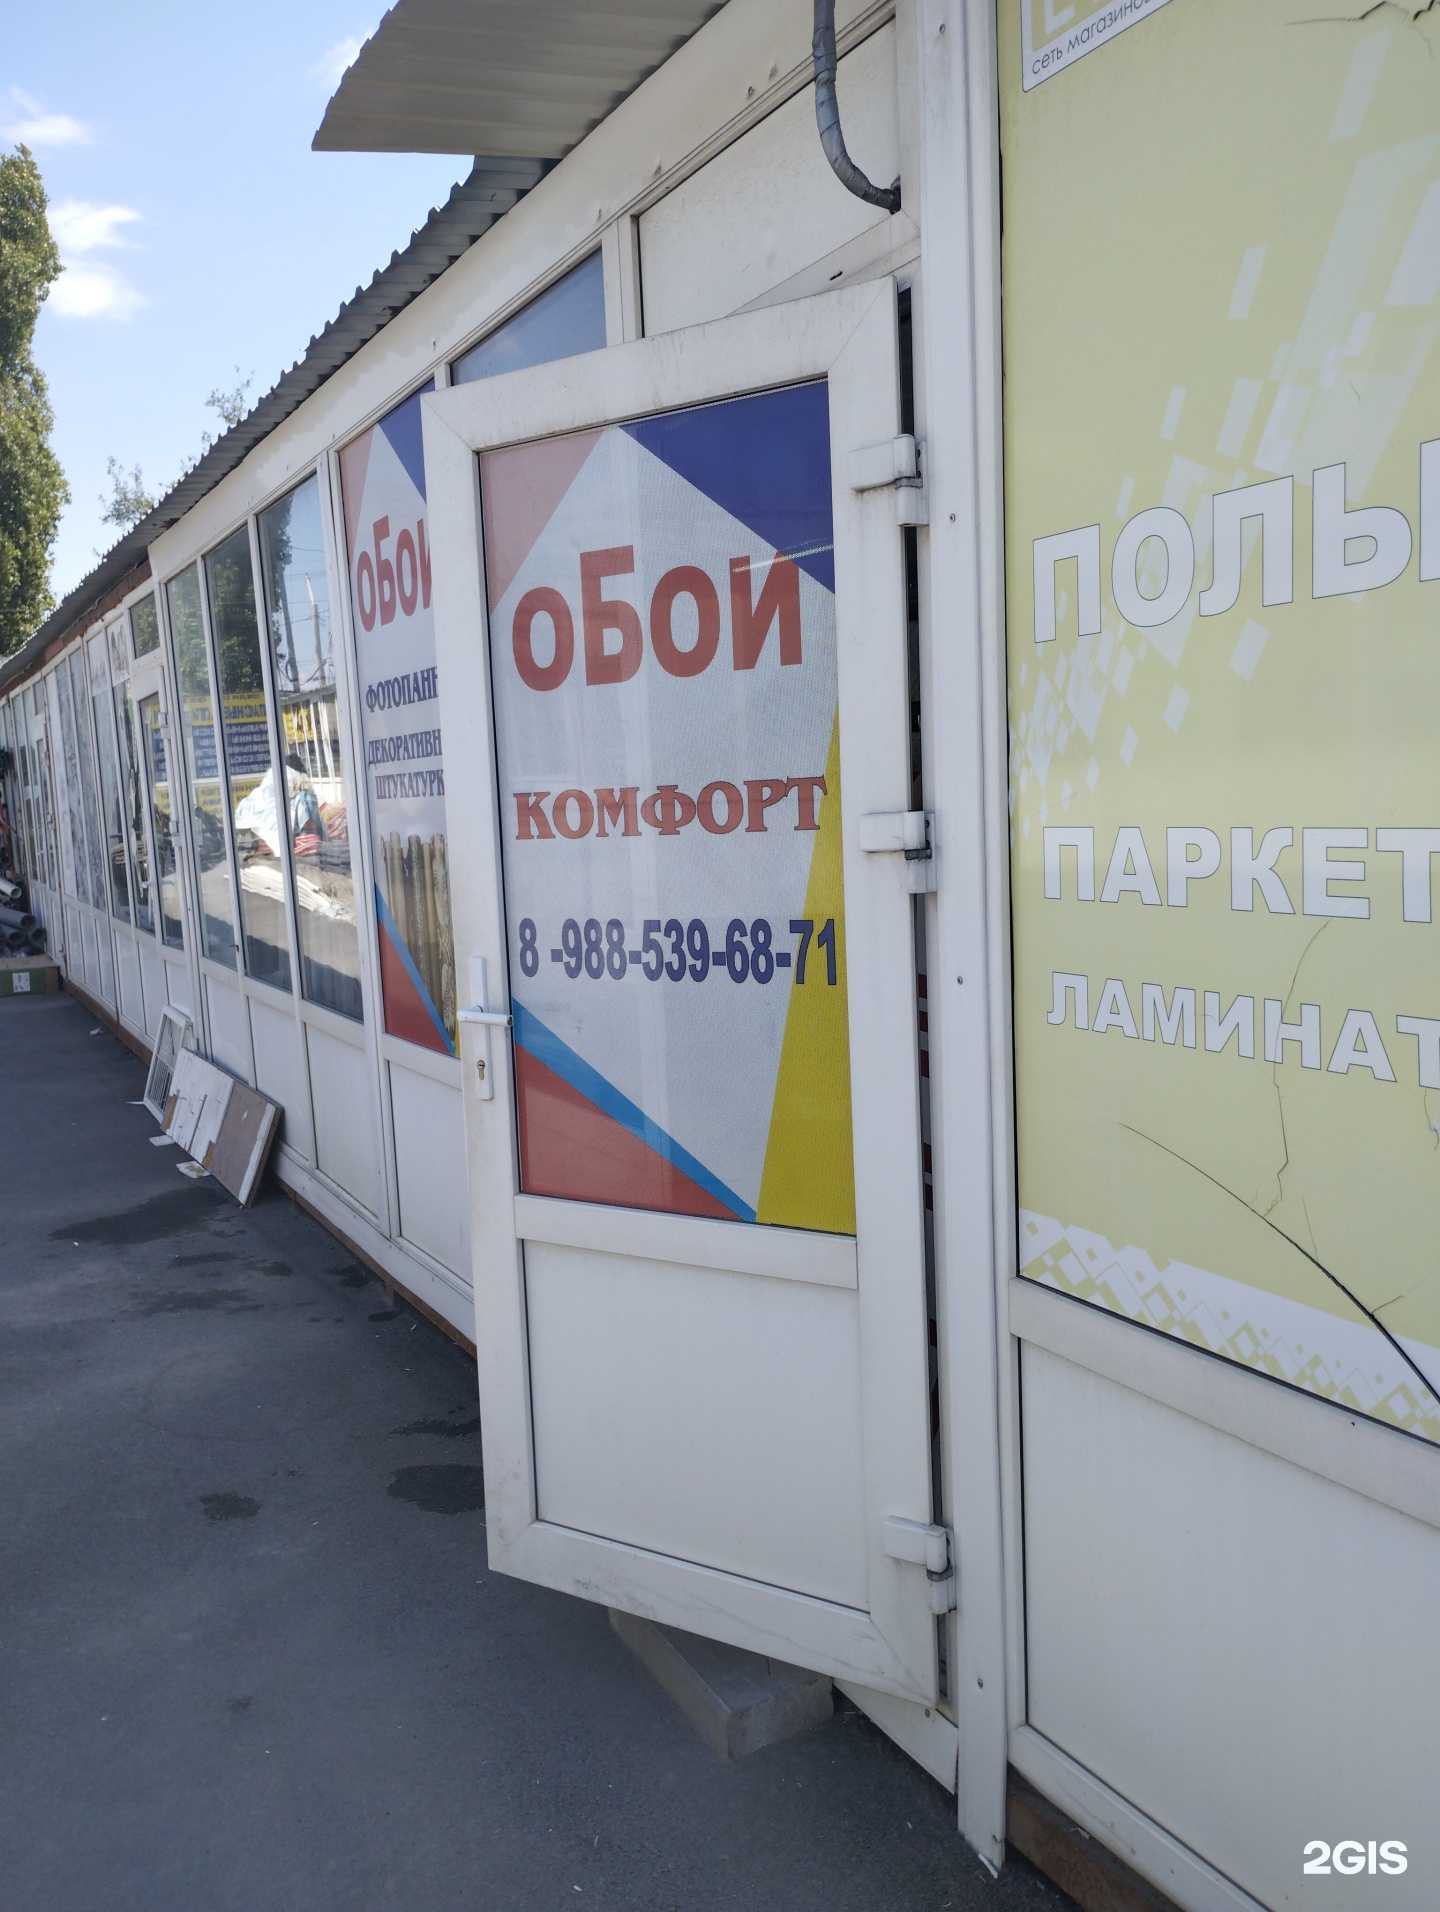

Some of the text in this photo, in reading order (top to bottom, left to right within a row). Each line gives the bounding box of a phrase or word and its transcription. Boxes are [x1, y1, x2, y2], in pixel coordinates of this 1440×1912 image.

[1031, 47, 1063, 75] сеть
[1066, 0, 1153, 54] магазино
[513, 776, 828, 840] КОМФОРТ
[1043, 826, 1440, 924] ПАРКЕТ
[1046, 970, 1440, 1090] ЛАМИНАТ
